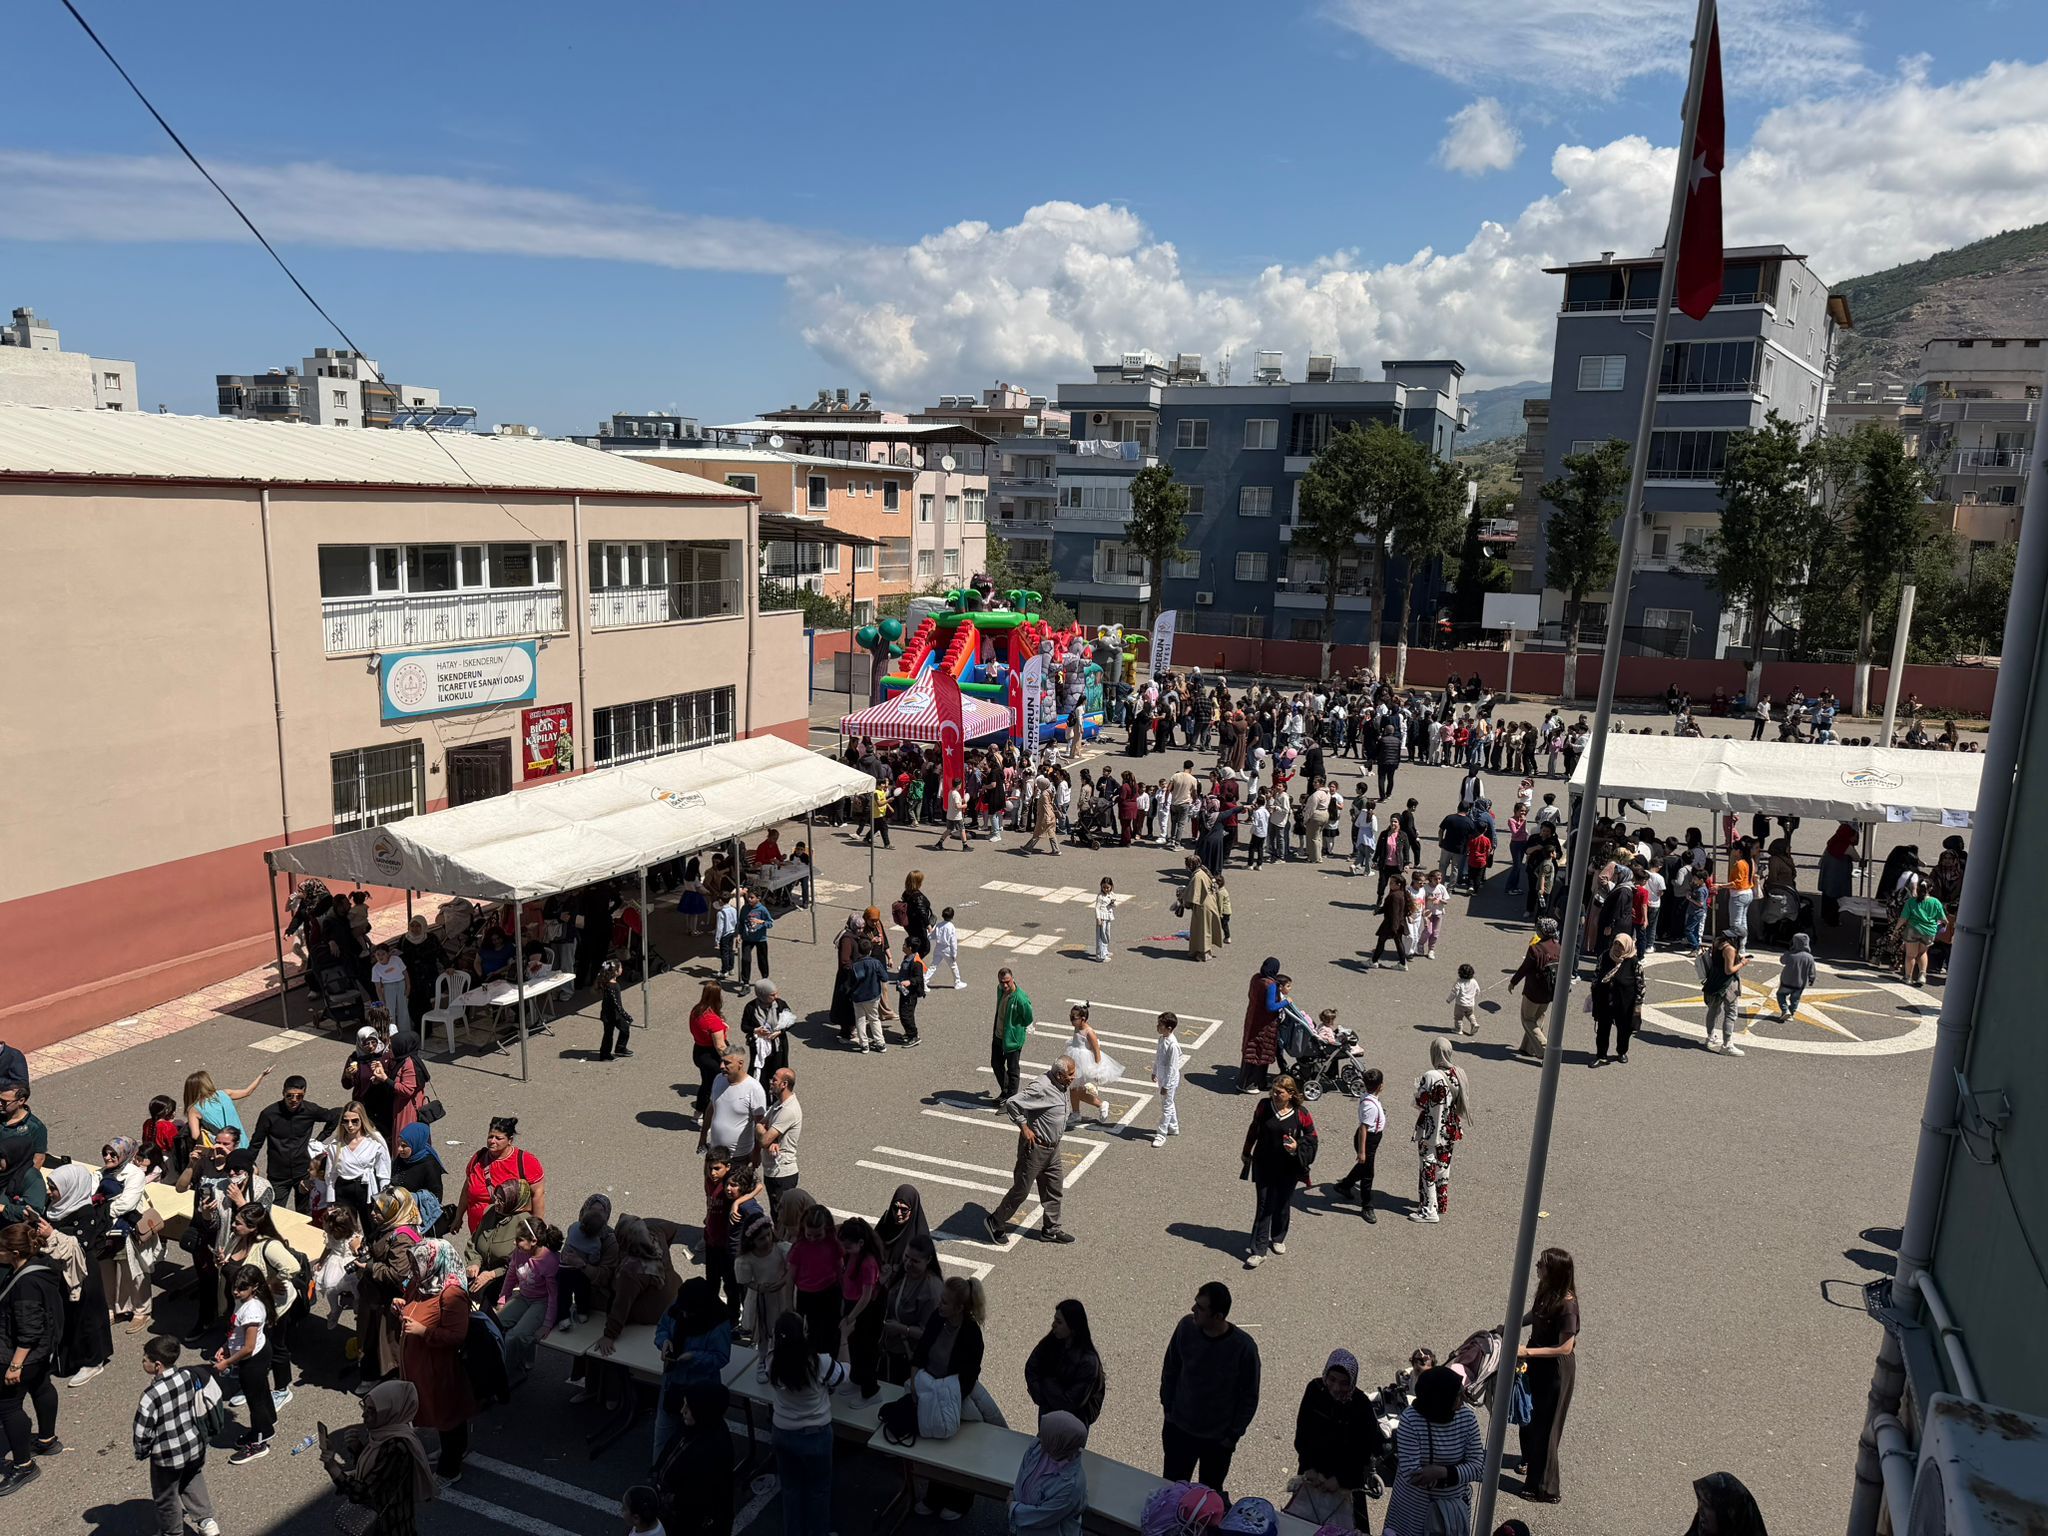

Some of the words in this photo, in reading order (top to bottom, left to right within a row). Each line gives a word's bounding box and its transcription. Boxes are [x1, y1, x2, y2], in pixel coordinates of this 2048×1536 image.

[436, 660, 457, 670] HATAY
[462, 655, 503, 668] İSKENDERUN
[437, 670, 483, 682] İSKENDERUN
[437, 682, 467, 692] TİCARET
[468, 680, 478, 689] VE
[478, 676, 503, 688] SANAYİ
[503, 674, 525, 684] ODASI
[437, 691, 474, 703] İLKOKULU
[529, 722, 554, 734] BİCAN
[525, 732, 558, 746] KAPILAY
